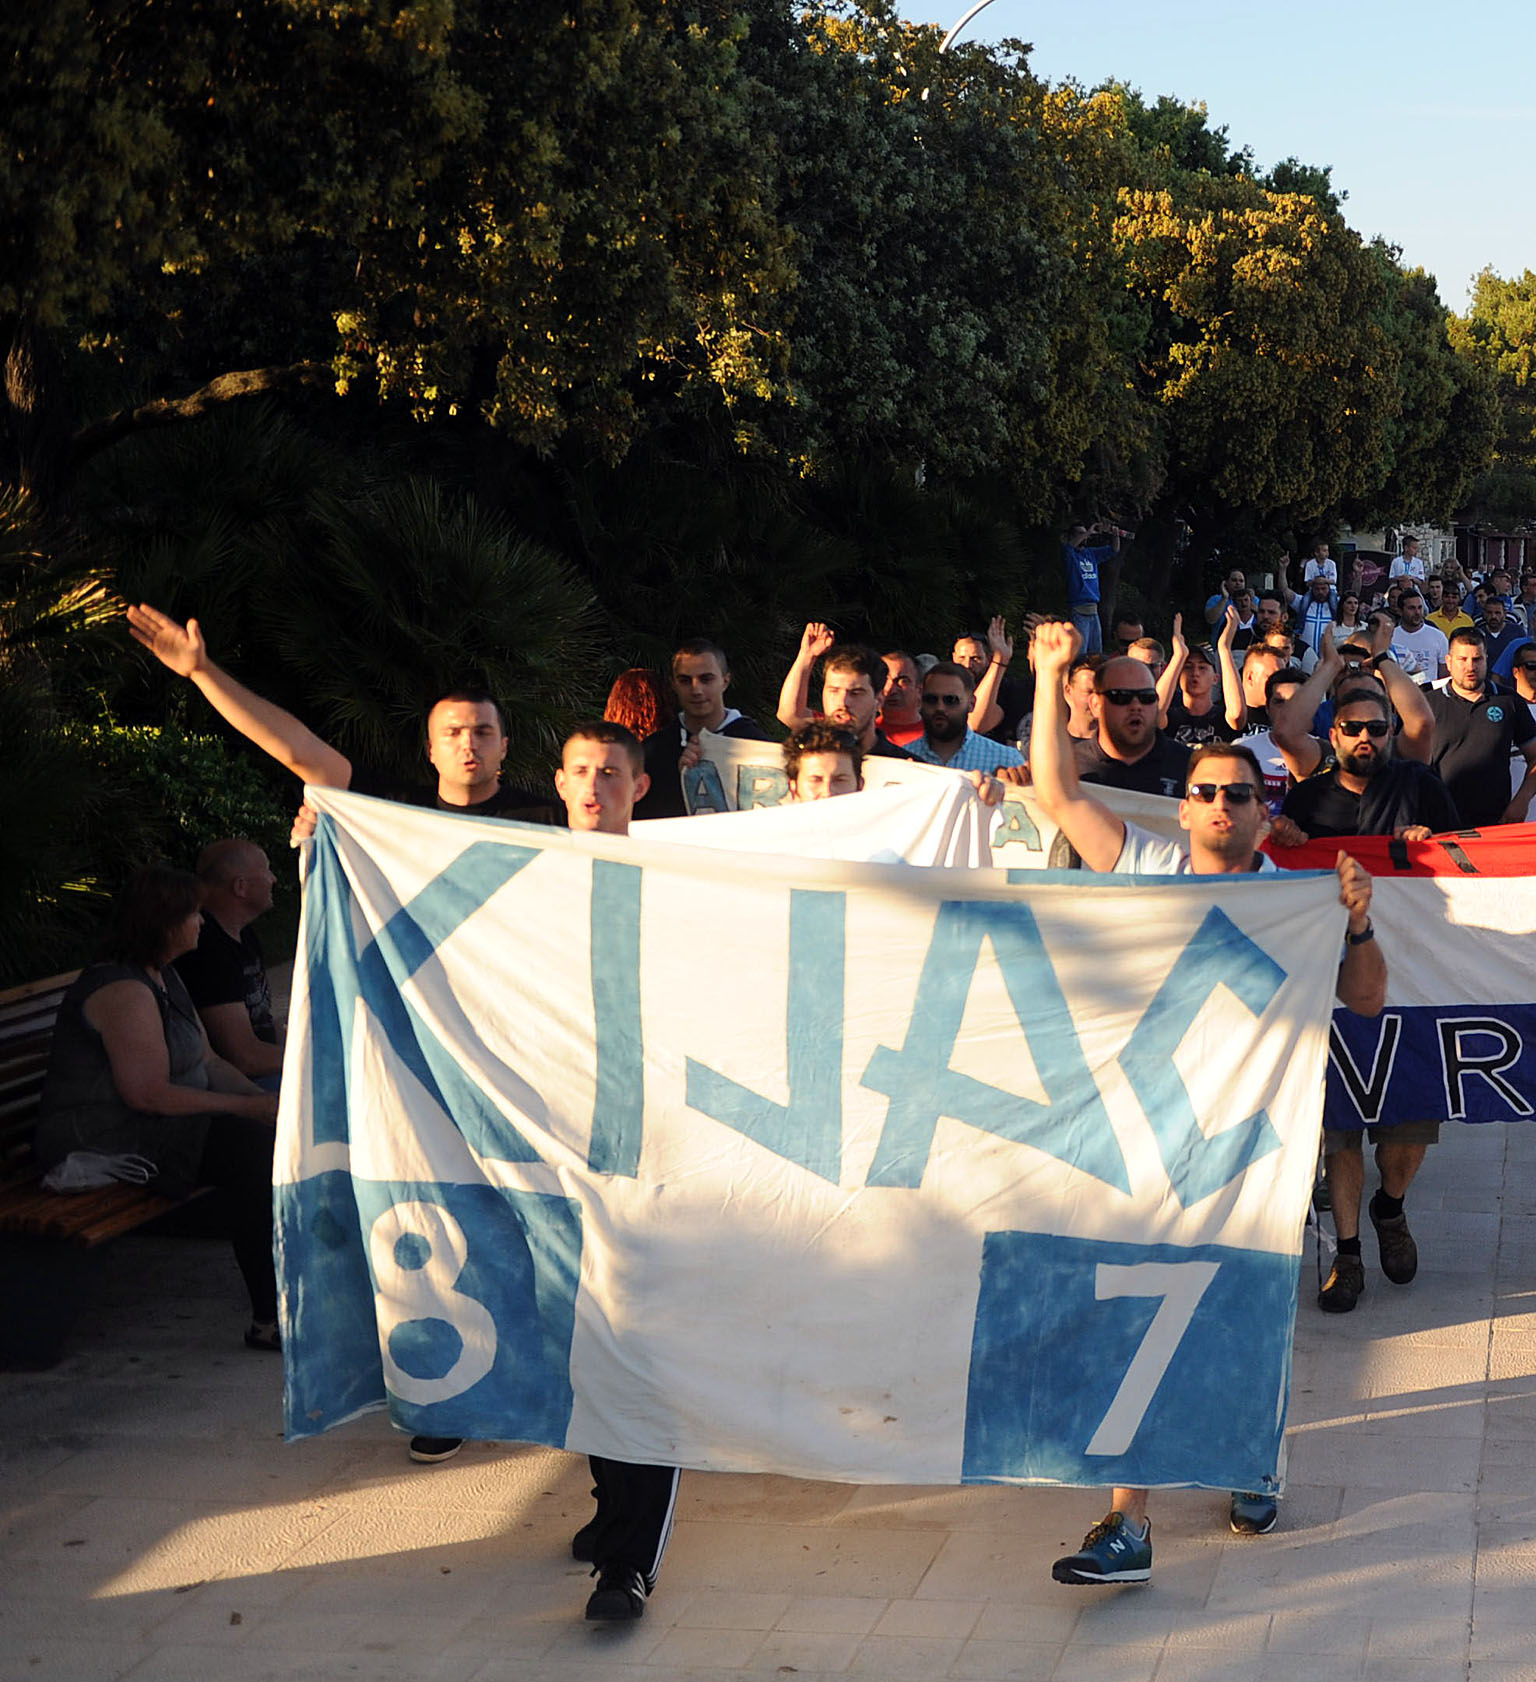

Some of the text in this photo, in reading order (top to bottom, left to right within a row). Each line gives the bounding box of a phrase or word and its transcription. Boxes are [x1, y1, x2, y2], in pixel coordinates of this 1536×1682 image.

[306, 822, 1289, 1211] KIJAC
[369, 1199, 1221, 1456] 8 7
[1110, 1538, 1126, 1554] N
